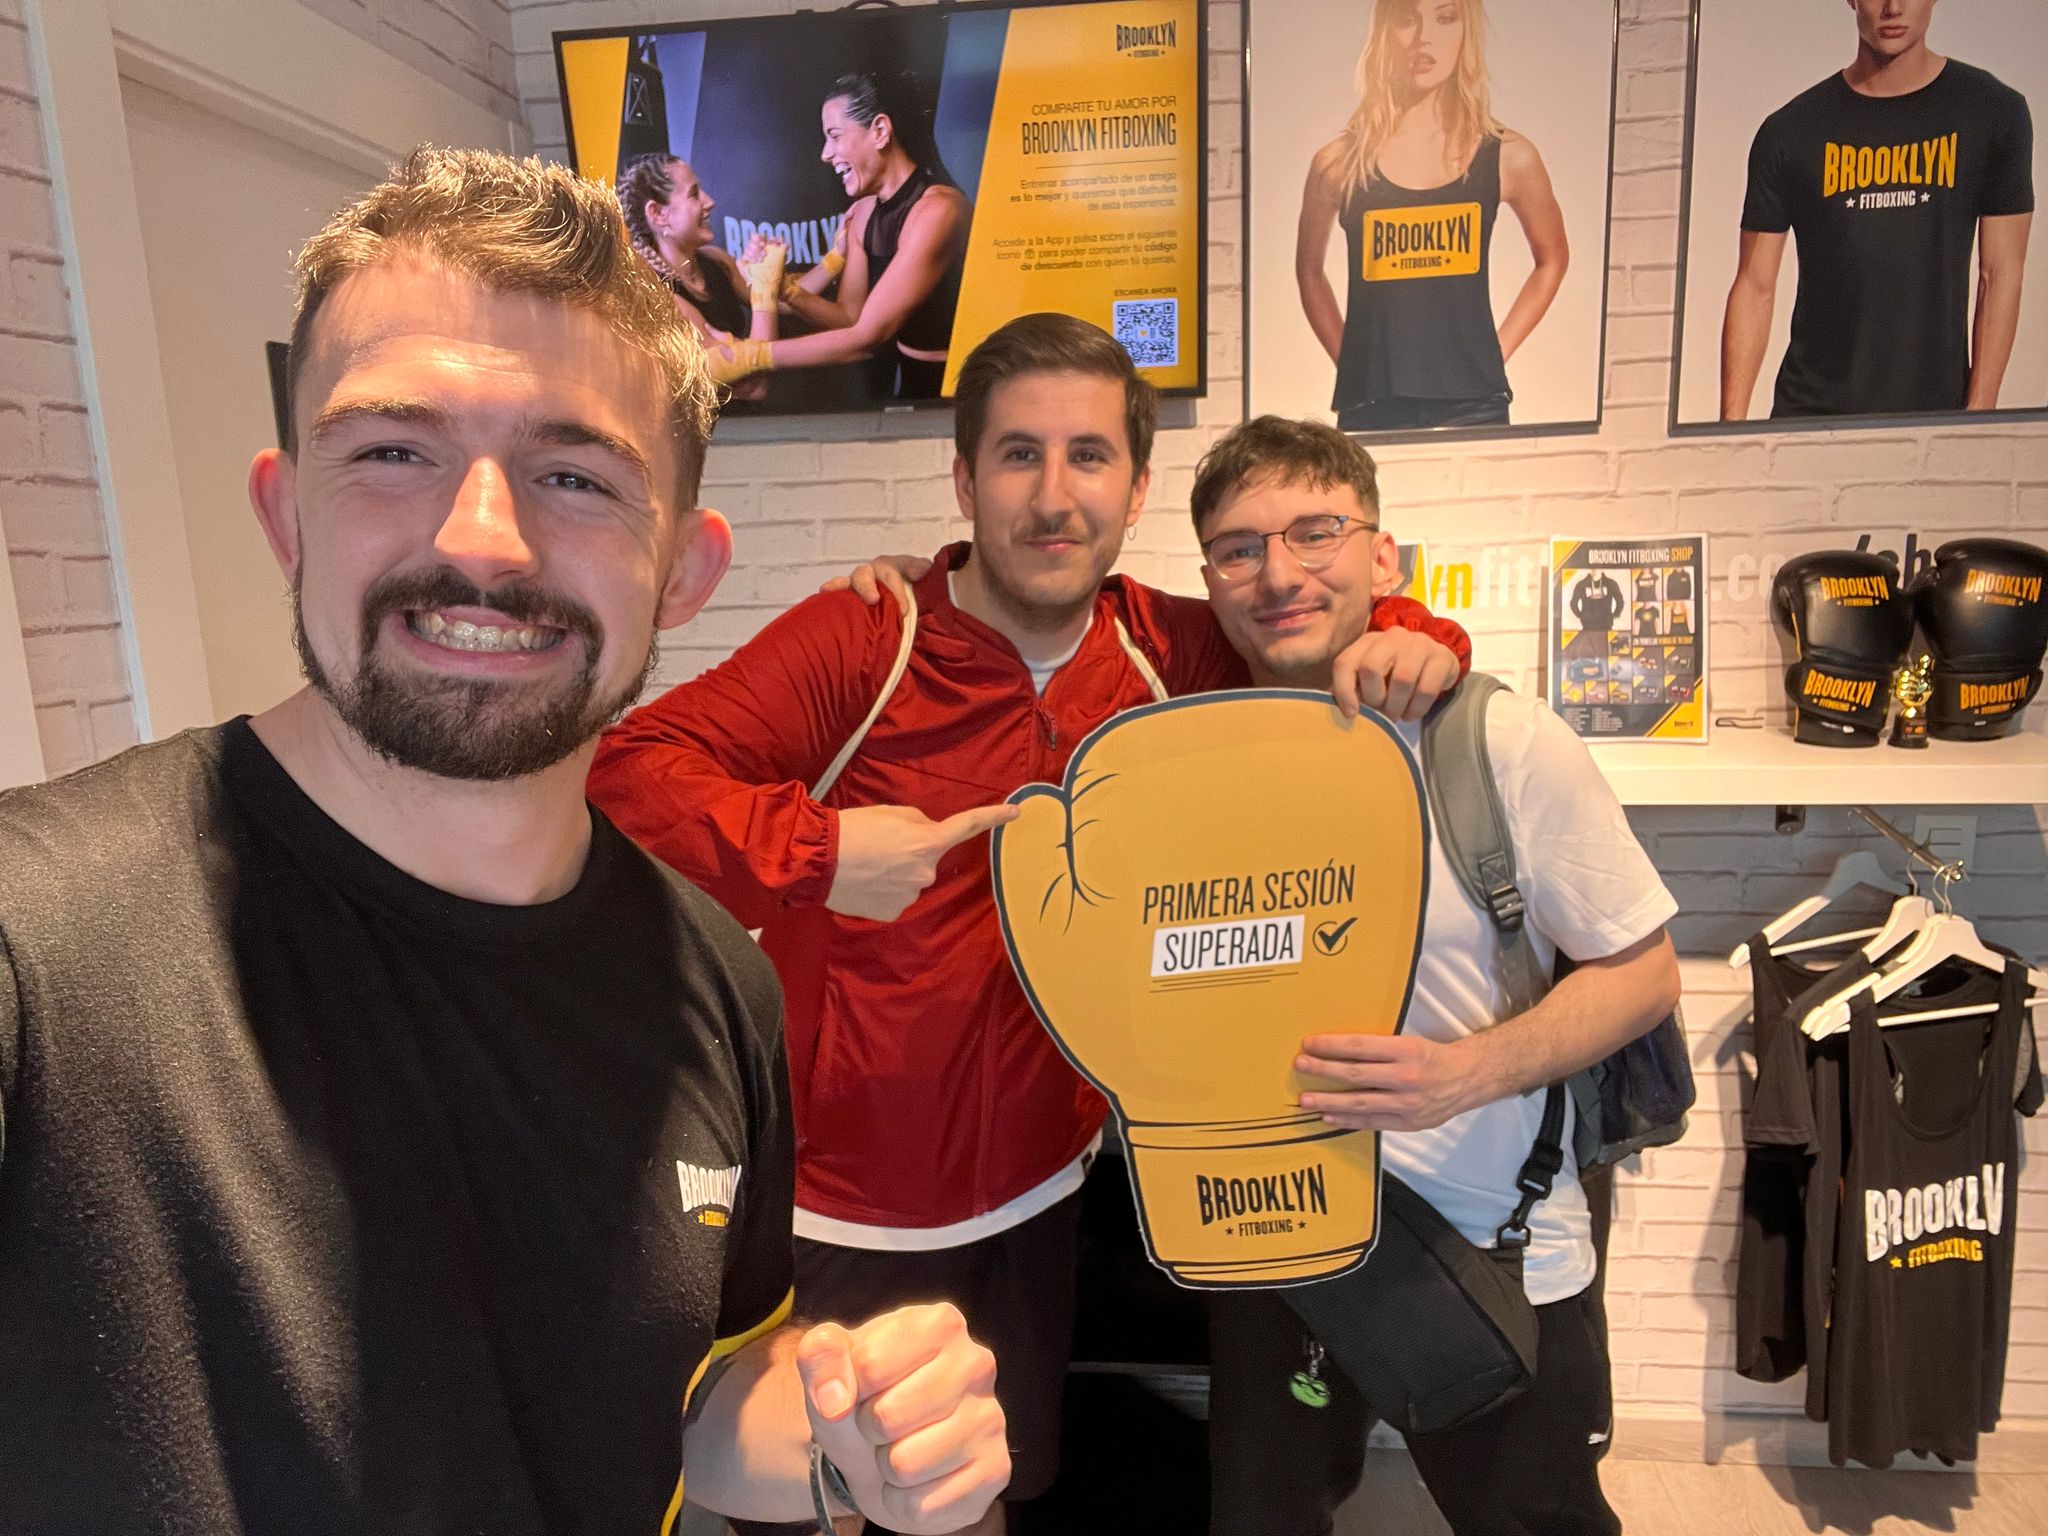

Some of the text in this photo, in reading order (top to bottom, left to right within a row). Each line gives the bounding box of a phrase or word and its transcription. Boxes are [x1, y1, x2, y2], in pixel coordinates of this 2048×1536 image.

[1116, 19, 1177, 51] BROOKLYN
[1031, 95, 1177, 116] COMPARTE TU AMOR POR
[1021, 112, 1177, 155] BROOKLYN FITBOXING
[1823, 132, 1958, 198] BROOKLYN
[1859, 190, 1916, 210] FITBOXING
[723, 215, 845, 265] BROKLY
[1373, 212, 1471, 261] BROOKLYN
[1401, 256, 1442, 269] FITBOXING
[1114, 286, 1178, 297] ESCANEA AHORA
[1588, 546, 1694, 564] BROOKLYN FITBOXING SHOP
[1820, 575, 1889, 601] BROOKLYN
[1964, 568, 2042, 603] BROOKLYN
[1803, 669, 1877, 708] BROOKLYN
[1960, 674, 2030, 710] BROOKLYN
[1142, 858, 1356, 925] PRIMERA SESIÓN
[1163, 921, 1294, 972] SUPERADA
[1196, 1163, 1328, 1226] BROOKLYN
[1239, 1219, 1294, 1237] FITBOXING
[1907, 1237, 1984, 1269] FITBOXING
